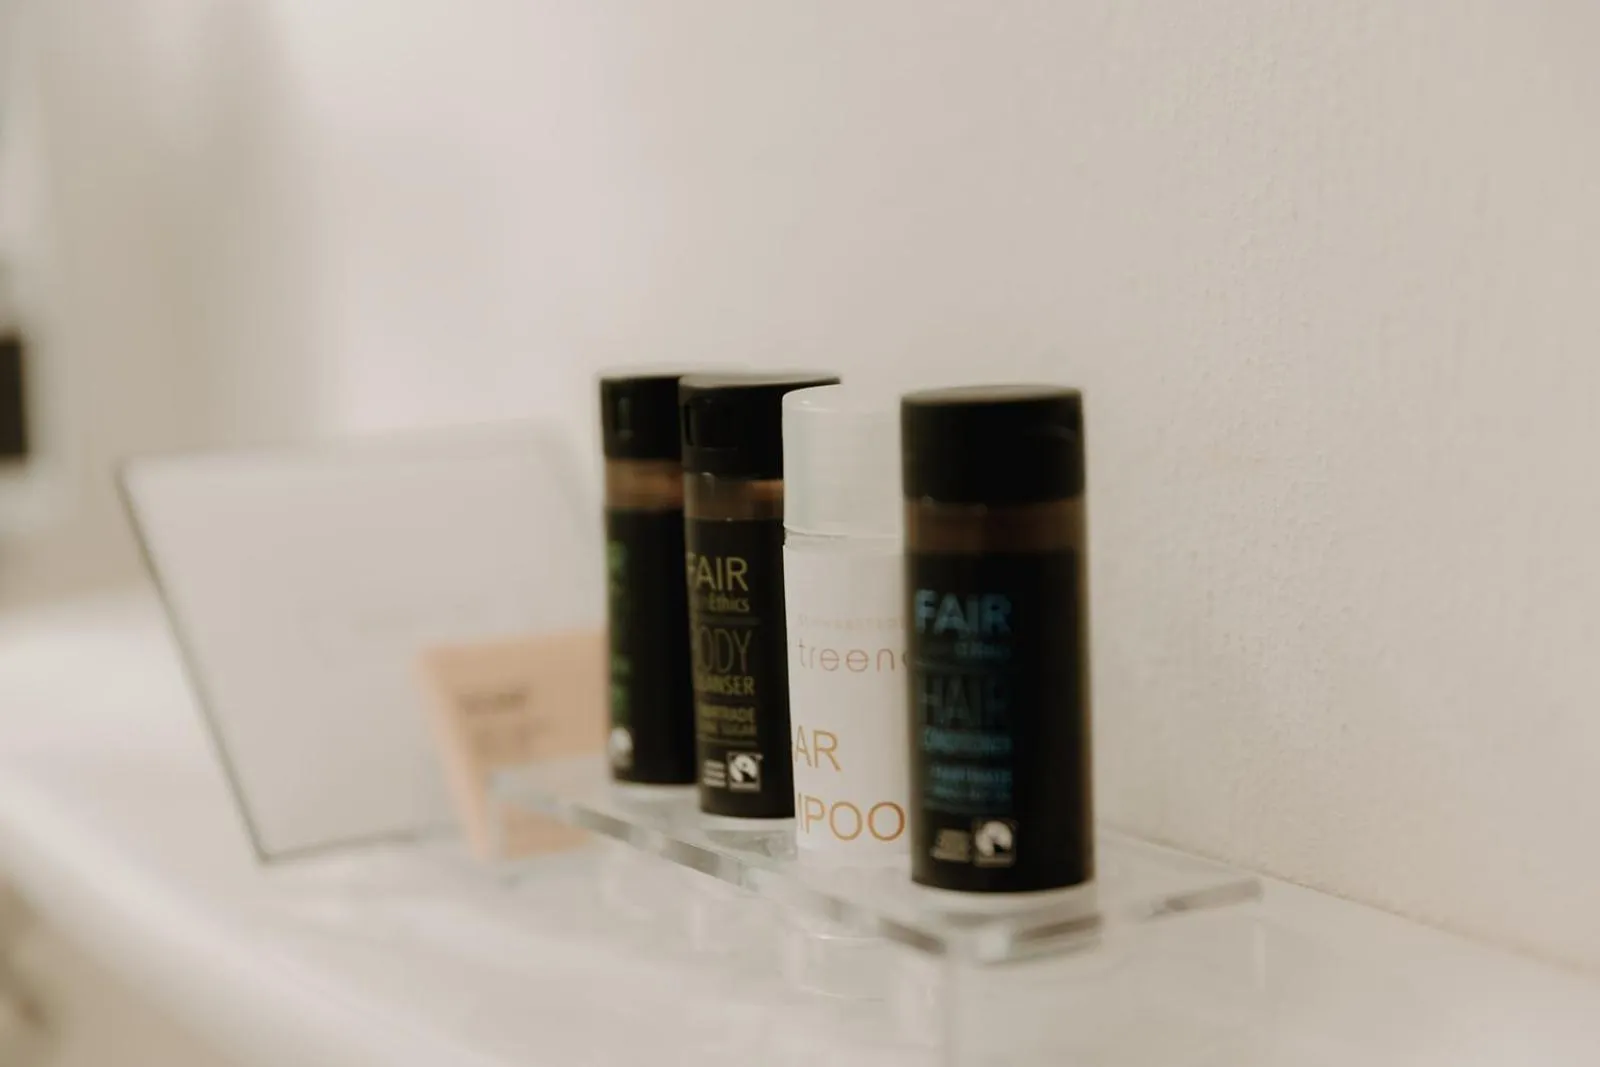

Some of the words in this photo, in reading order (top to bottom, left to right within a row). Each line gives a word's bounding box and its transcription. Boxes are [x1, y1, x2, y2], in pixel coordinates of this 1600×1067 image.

[685, 551, 749, 592] FAIR
[914, 588, 1012, 635] FAIR
[698, 627, 752, 674] ODY
[798, 792, 906, 842] POO
